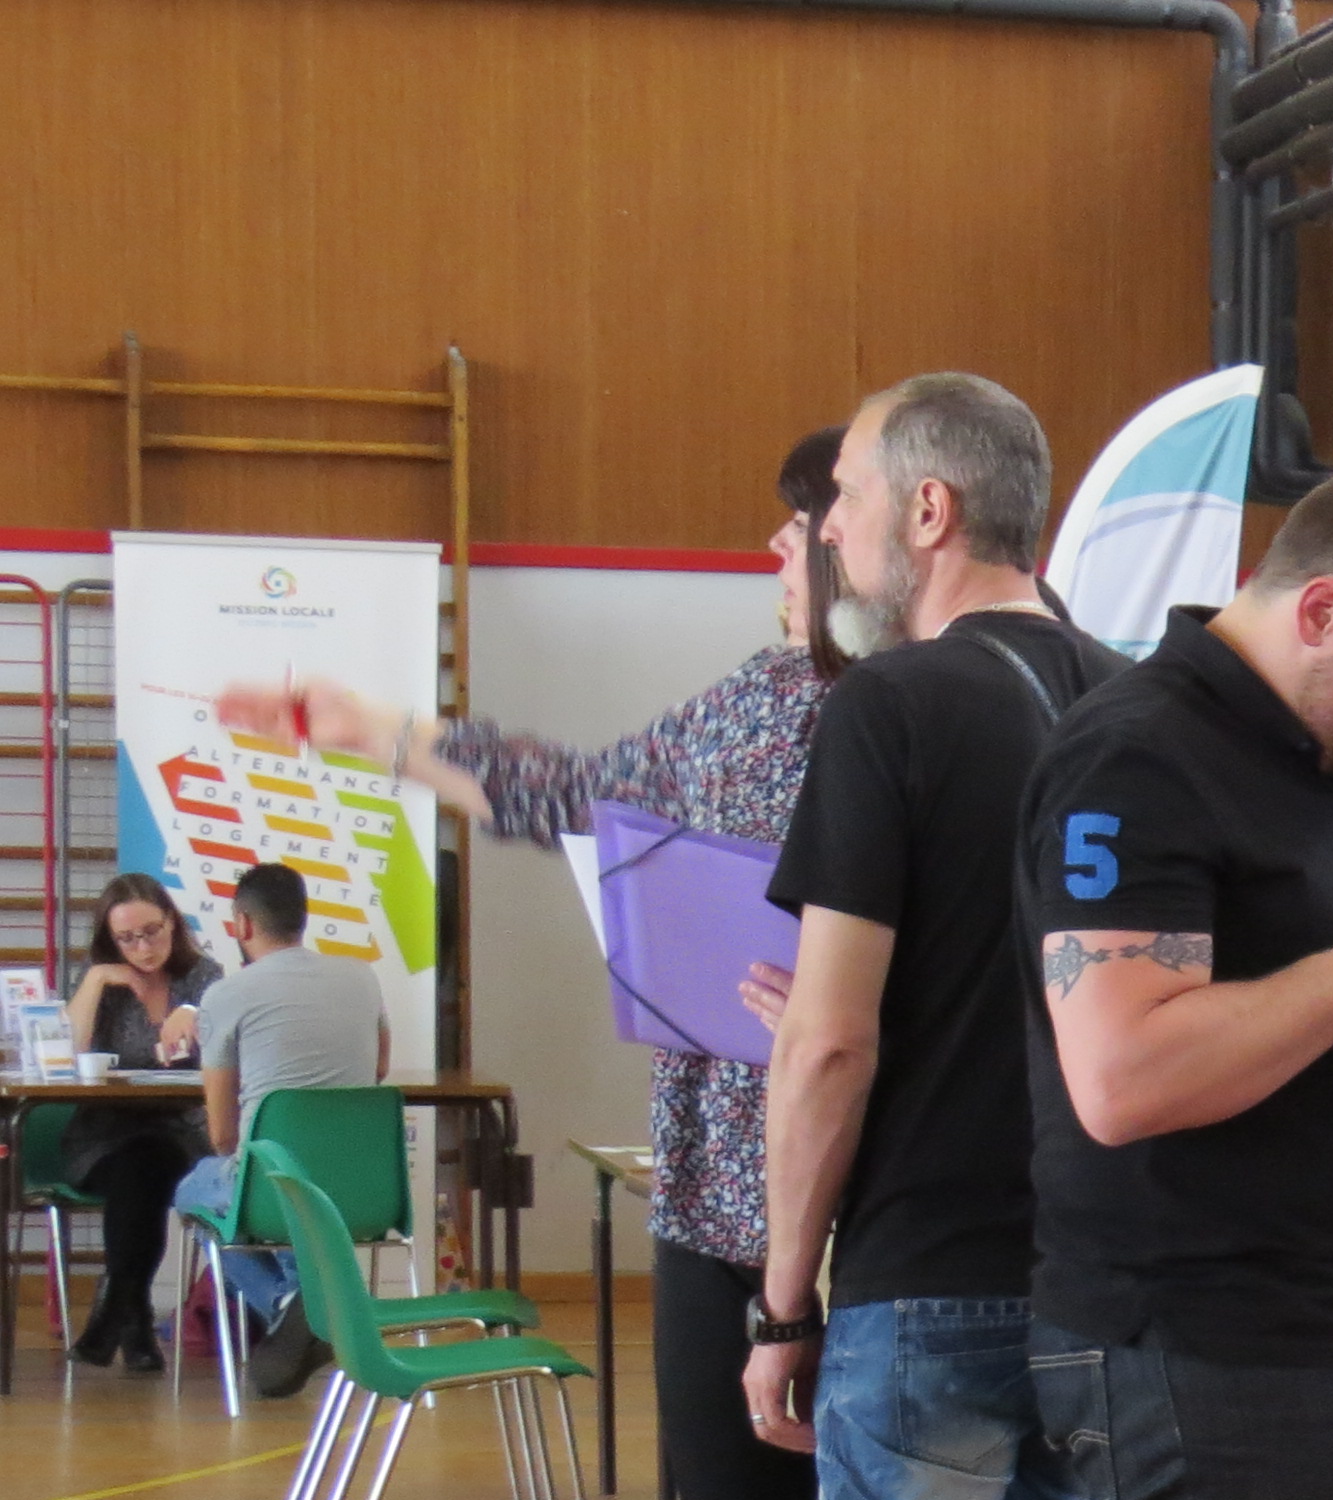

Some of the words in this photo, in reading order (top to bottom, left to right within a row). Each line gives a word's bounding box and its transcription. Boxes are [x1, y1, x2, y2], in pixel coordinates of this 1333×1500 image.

[218, 605, 277, 616] MISSION
[282, 606, 335, 618] LOCALE
[185, 745, 402, 797] ALTERNANCE
[180, 780, 395, 834] FORMATION
[173, 818, 388, 870] LOGEMENT
[1064, 812, 1121, 900] 5
